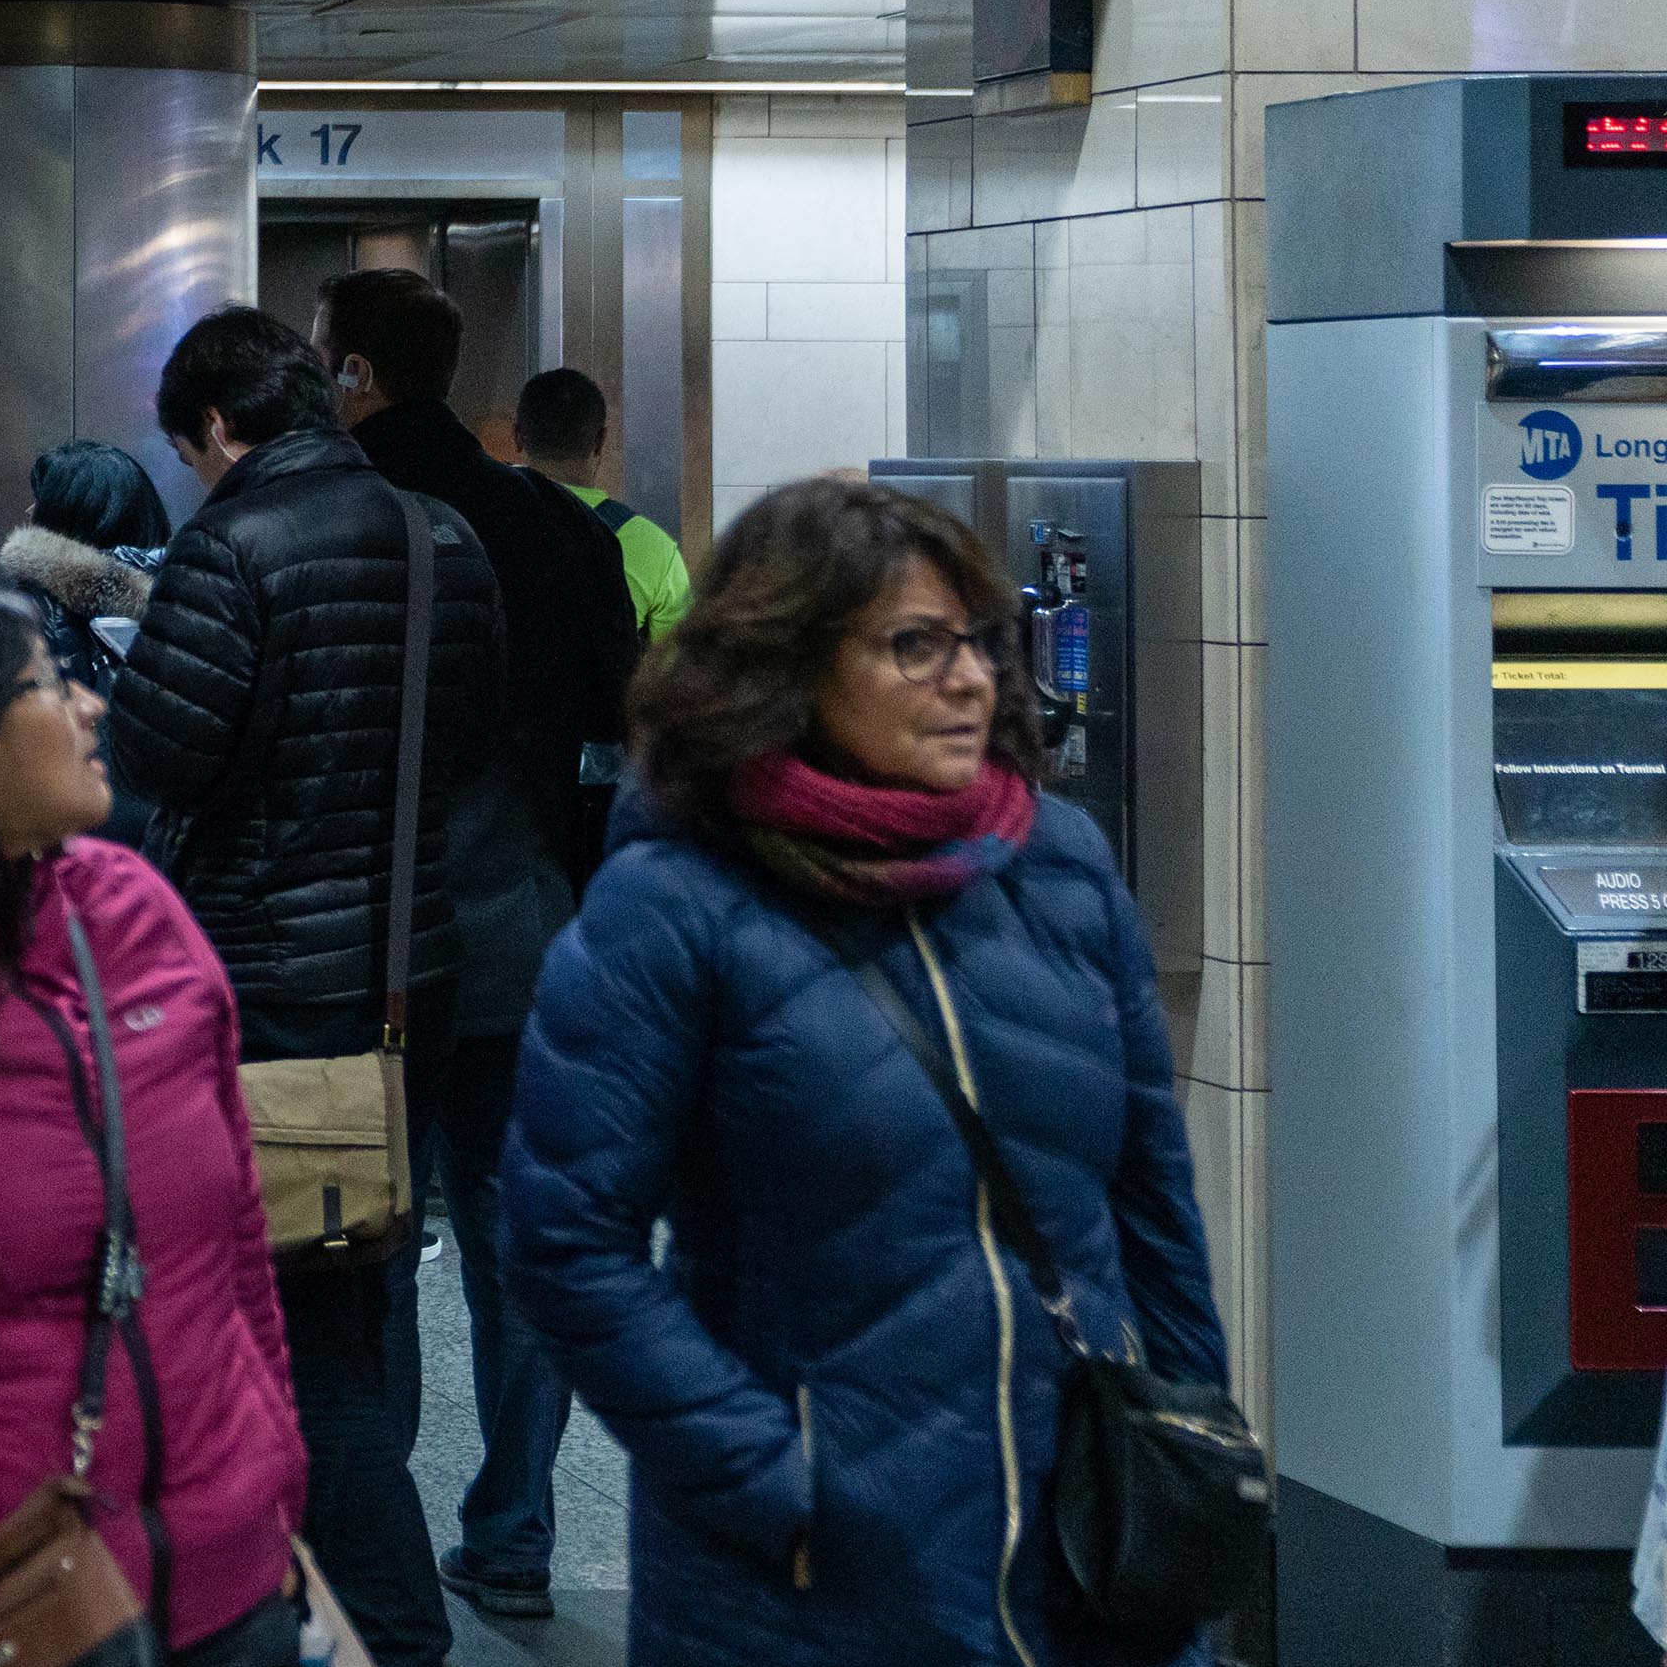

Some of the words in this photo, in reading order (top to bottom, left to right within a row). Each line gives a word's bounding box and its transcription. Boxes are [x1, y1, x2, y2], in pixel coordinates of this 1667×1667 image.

[310, 124, 362, 165] 17
[1596, 434, 1667, 464] Long
[1502, 672, 1534, 680] Ticket
[1495, 764, 1531, 774] Follow
[1533, 764, 1599, 774] Instructions
[1600, 765, 1616, 774] on
[1615, 763, 1666, 774] Terminal
[1596, 873, 1641, 888] AUDIO
[1599, 893, 1649, 909] PRESS
[1651, 894, 1661, 910] 5
